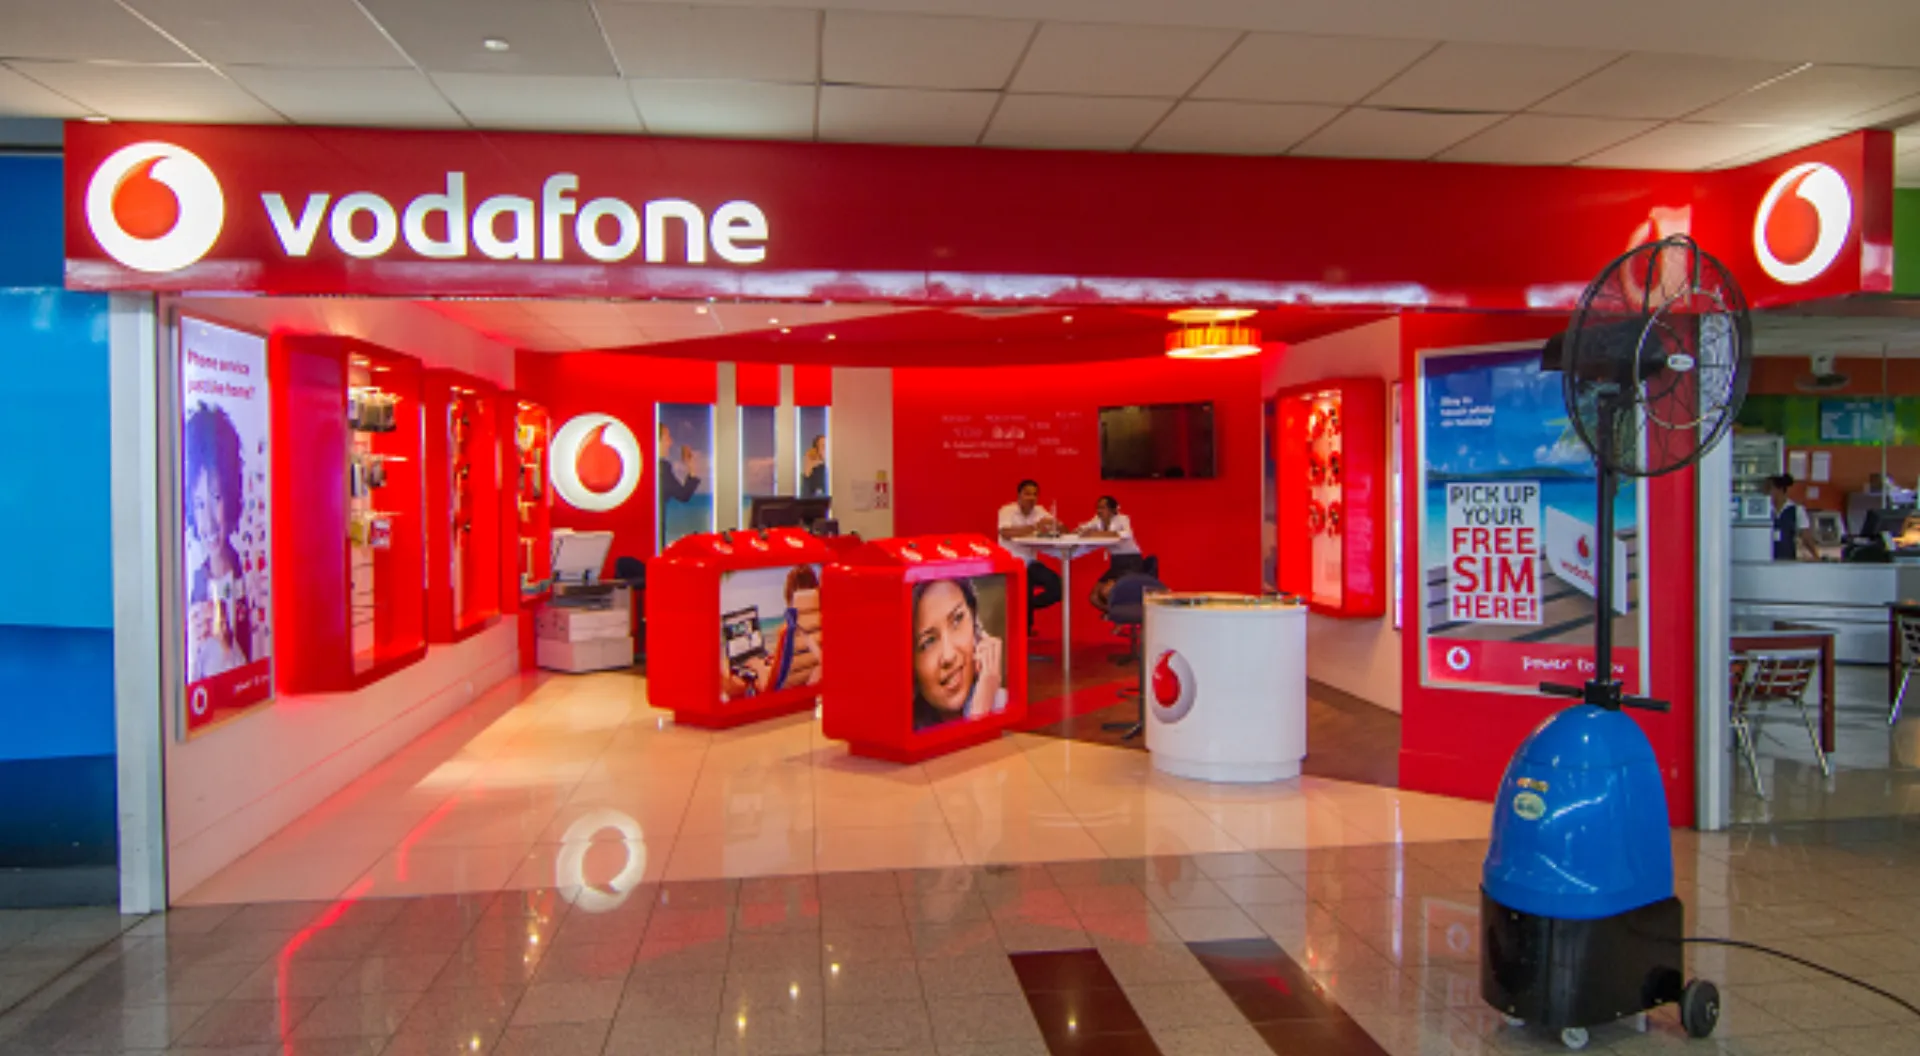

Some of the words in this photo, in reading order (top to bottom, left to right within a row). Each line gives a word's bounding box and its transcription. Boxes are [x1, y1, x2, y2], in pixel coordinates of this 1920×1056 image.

[261, 171, 769, 262] vodafone
[1450, 485, 1499, 504] PICK
[1504, 485, 1537, 503] UP
[1463, 506, 1524, 525] YOUR
[1452, 527, 1537, 554] FREE
[1453, 556, 1535, 594] SIM
[1453, 595, 1538, 621] HERE!
